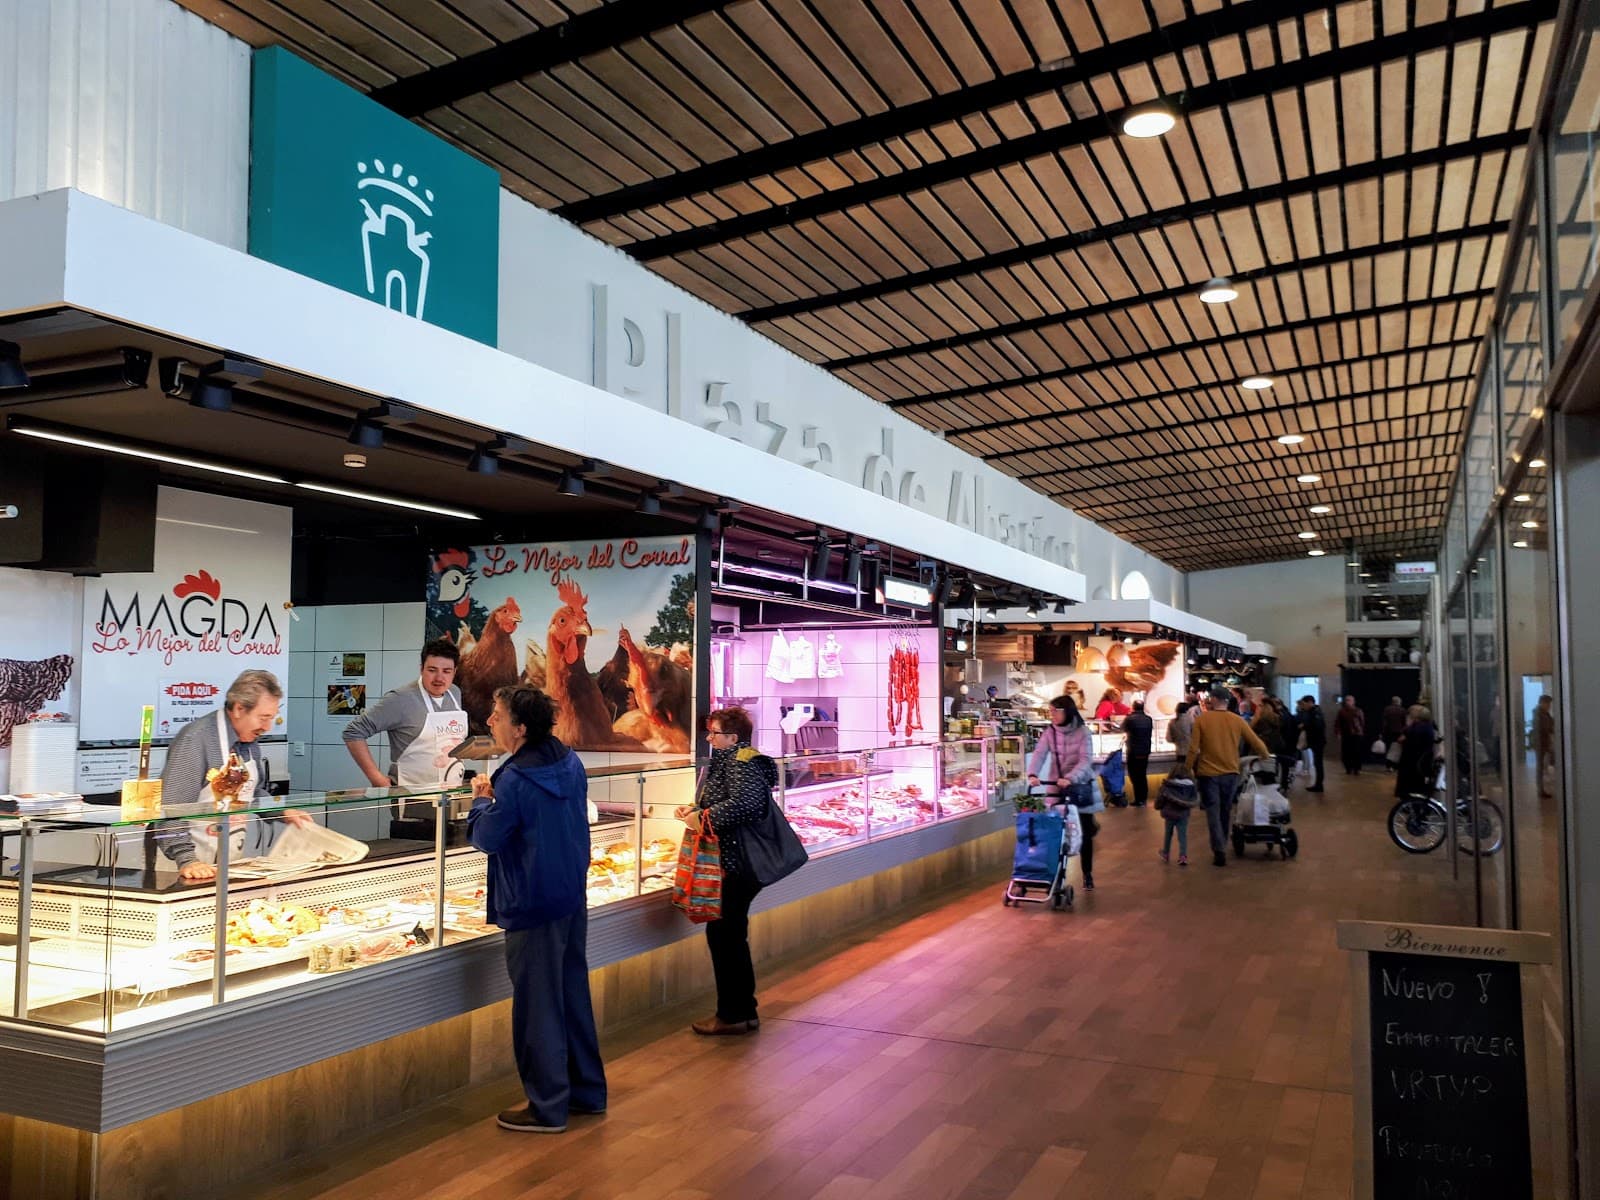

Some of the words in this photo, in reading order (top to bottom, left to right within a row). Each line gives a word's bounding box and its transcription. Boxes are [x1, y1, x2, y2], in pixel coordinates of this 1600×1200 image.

[481, 545, 517, 578] Lo
[521, 546, 583, 586] Mejor
[587, 544, 615, 569] del
[620, 538, 691, 569] Corral
[99, 588, 278, 640] MAGDA
[92, 622, 130, 654] Lo
[136, 628, 194, 665] Mejor
[198, 631, 221, 653] del
[227, 629, 281, 656] Corral
[172, 685, 190, 696] PIDA
[1384, 927, 1507, 956] Bienvenue
[1382, 967, 1456, 1000] NUEVO
